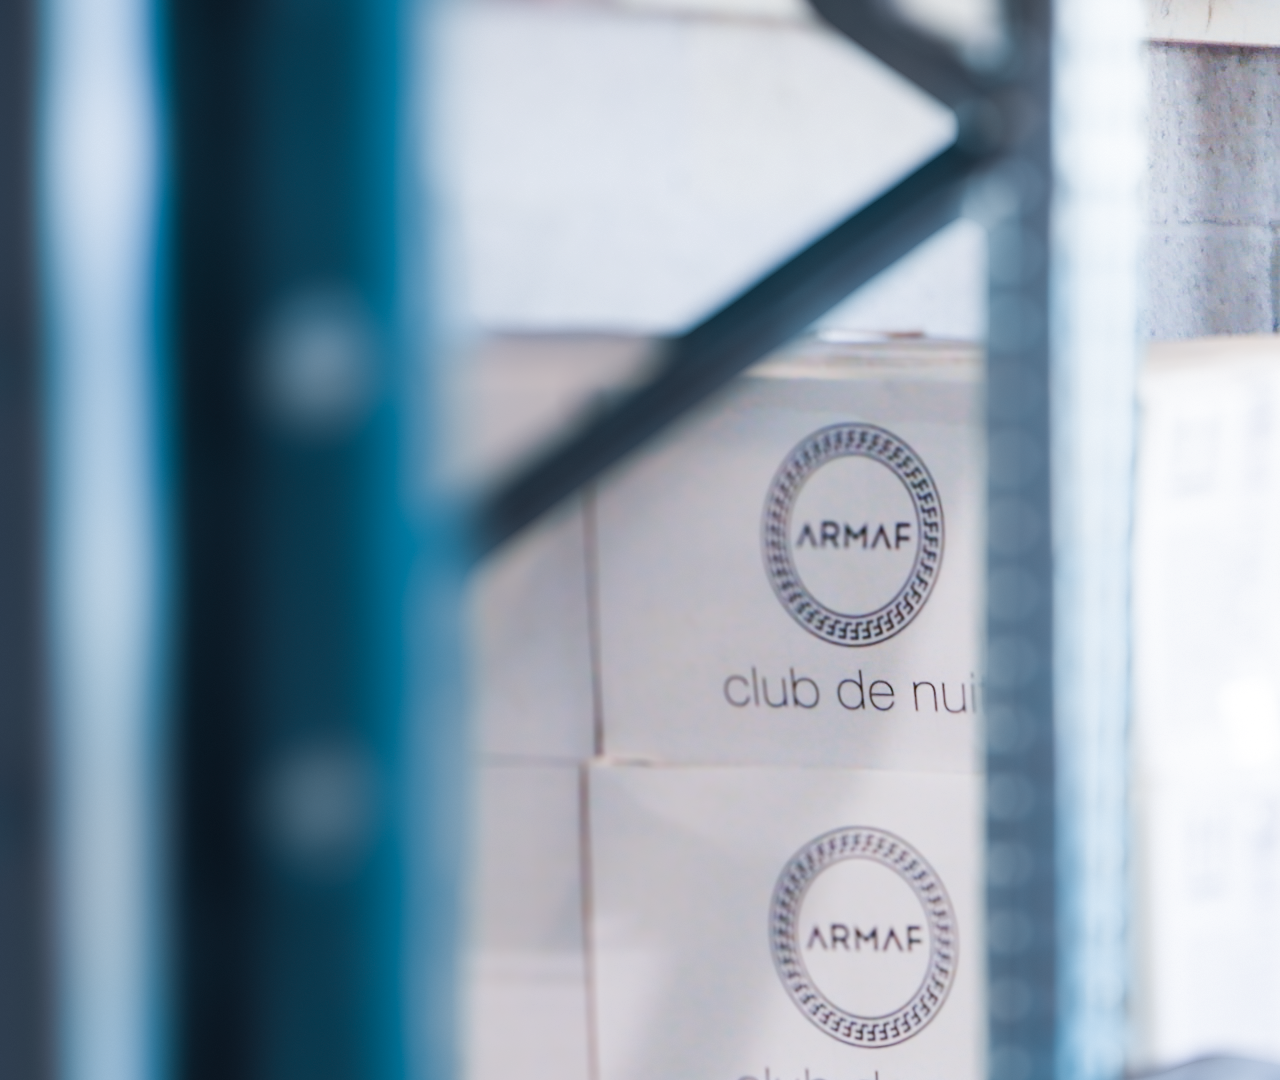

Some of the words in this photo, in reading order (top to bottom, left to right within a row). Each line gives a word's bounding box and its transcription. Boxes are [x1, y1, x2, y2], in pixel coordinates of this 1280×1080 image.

[796, 520, 911, 551] ARMAF
[723, 666, 820, 709] club
[837, 669, 895, 711] de
[912, 672, 979, 714] nui
[806, 923, 922, 953] ARMAF
